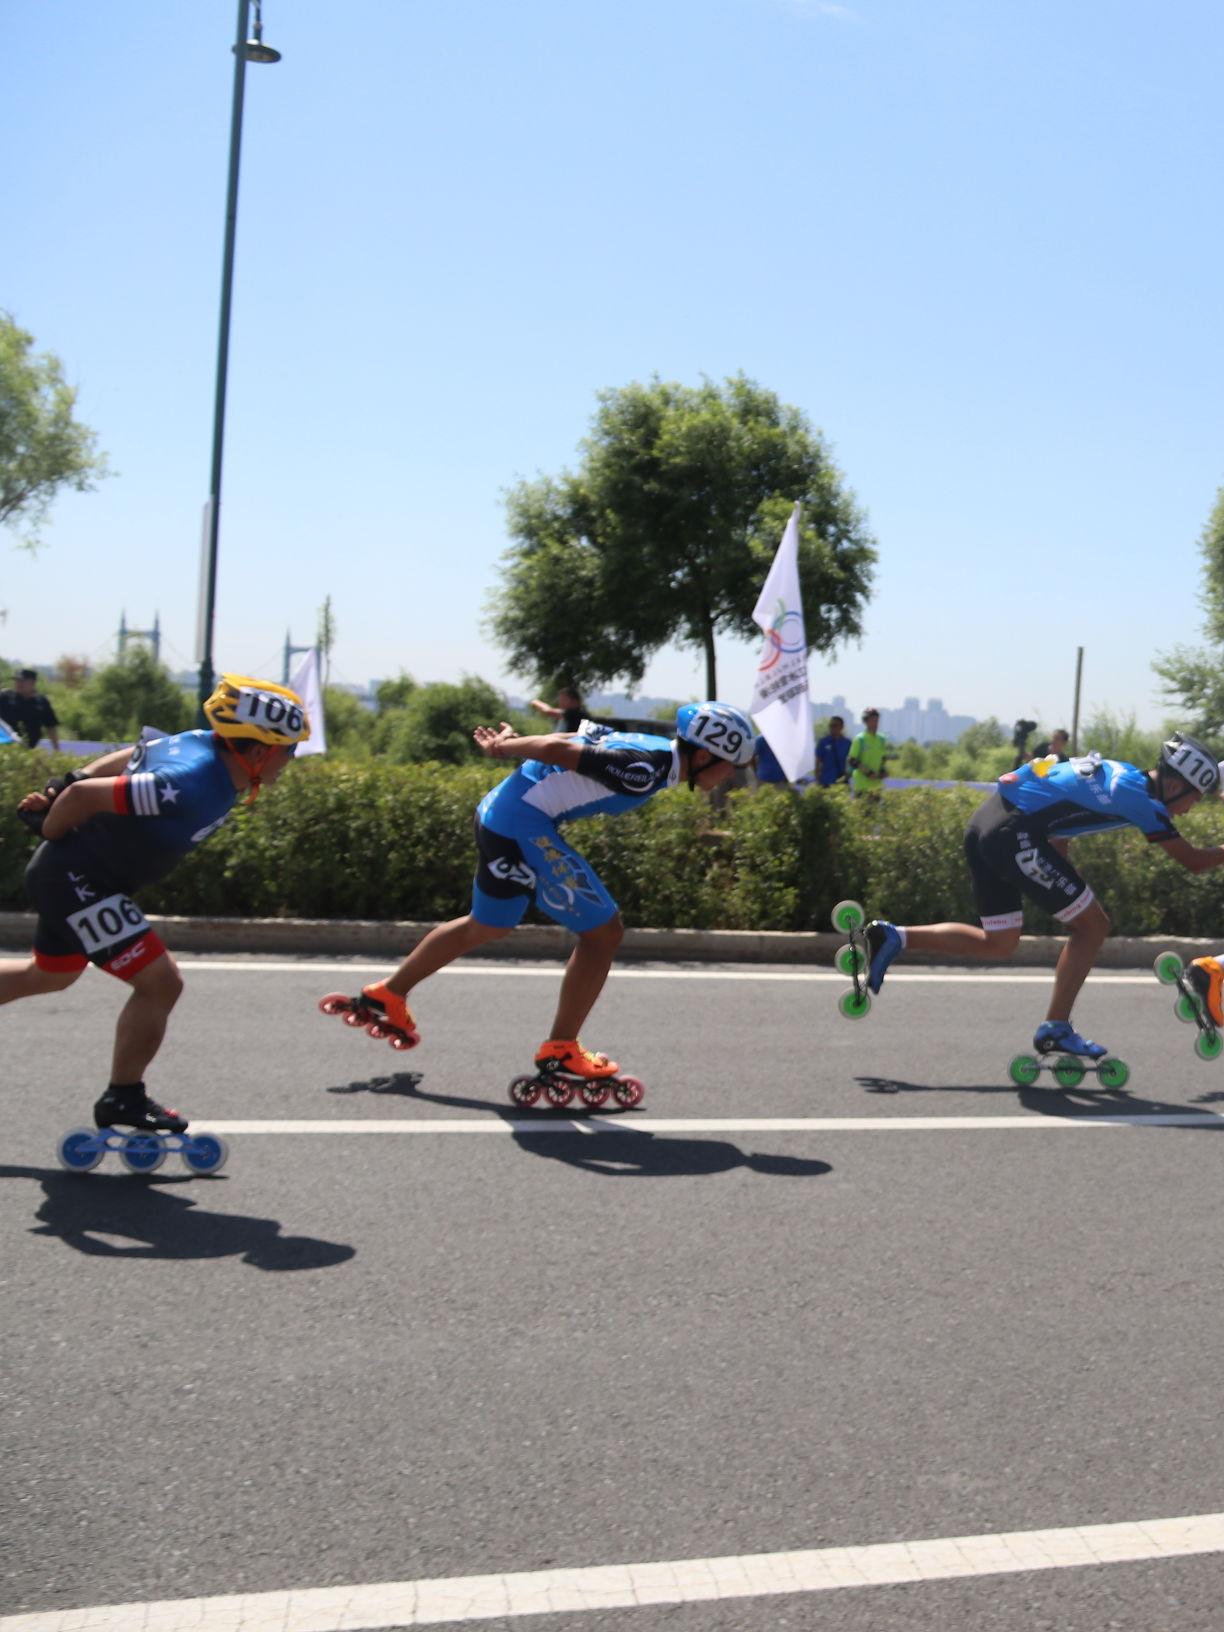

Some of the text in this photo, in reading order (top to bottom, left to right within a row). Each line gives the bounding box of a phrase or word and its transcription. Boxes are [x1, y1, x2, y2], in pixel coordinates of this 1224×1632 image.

[244, 693, 304, 732] 106
[694, 715, 743, 754] 129
[1176, 749, 1215, 787] 110
[78, 898, 142, 943] 106
